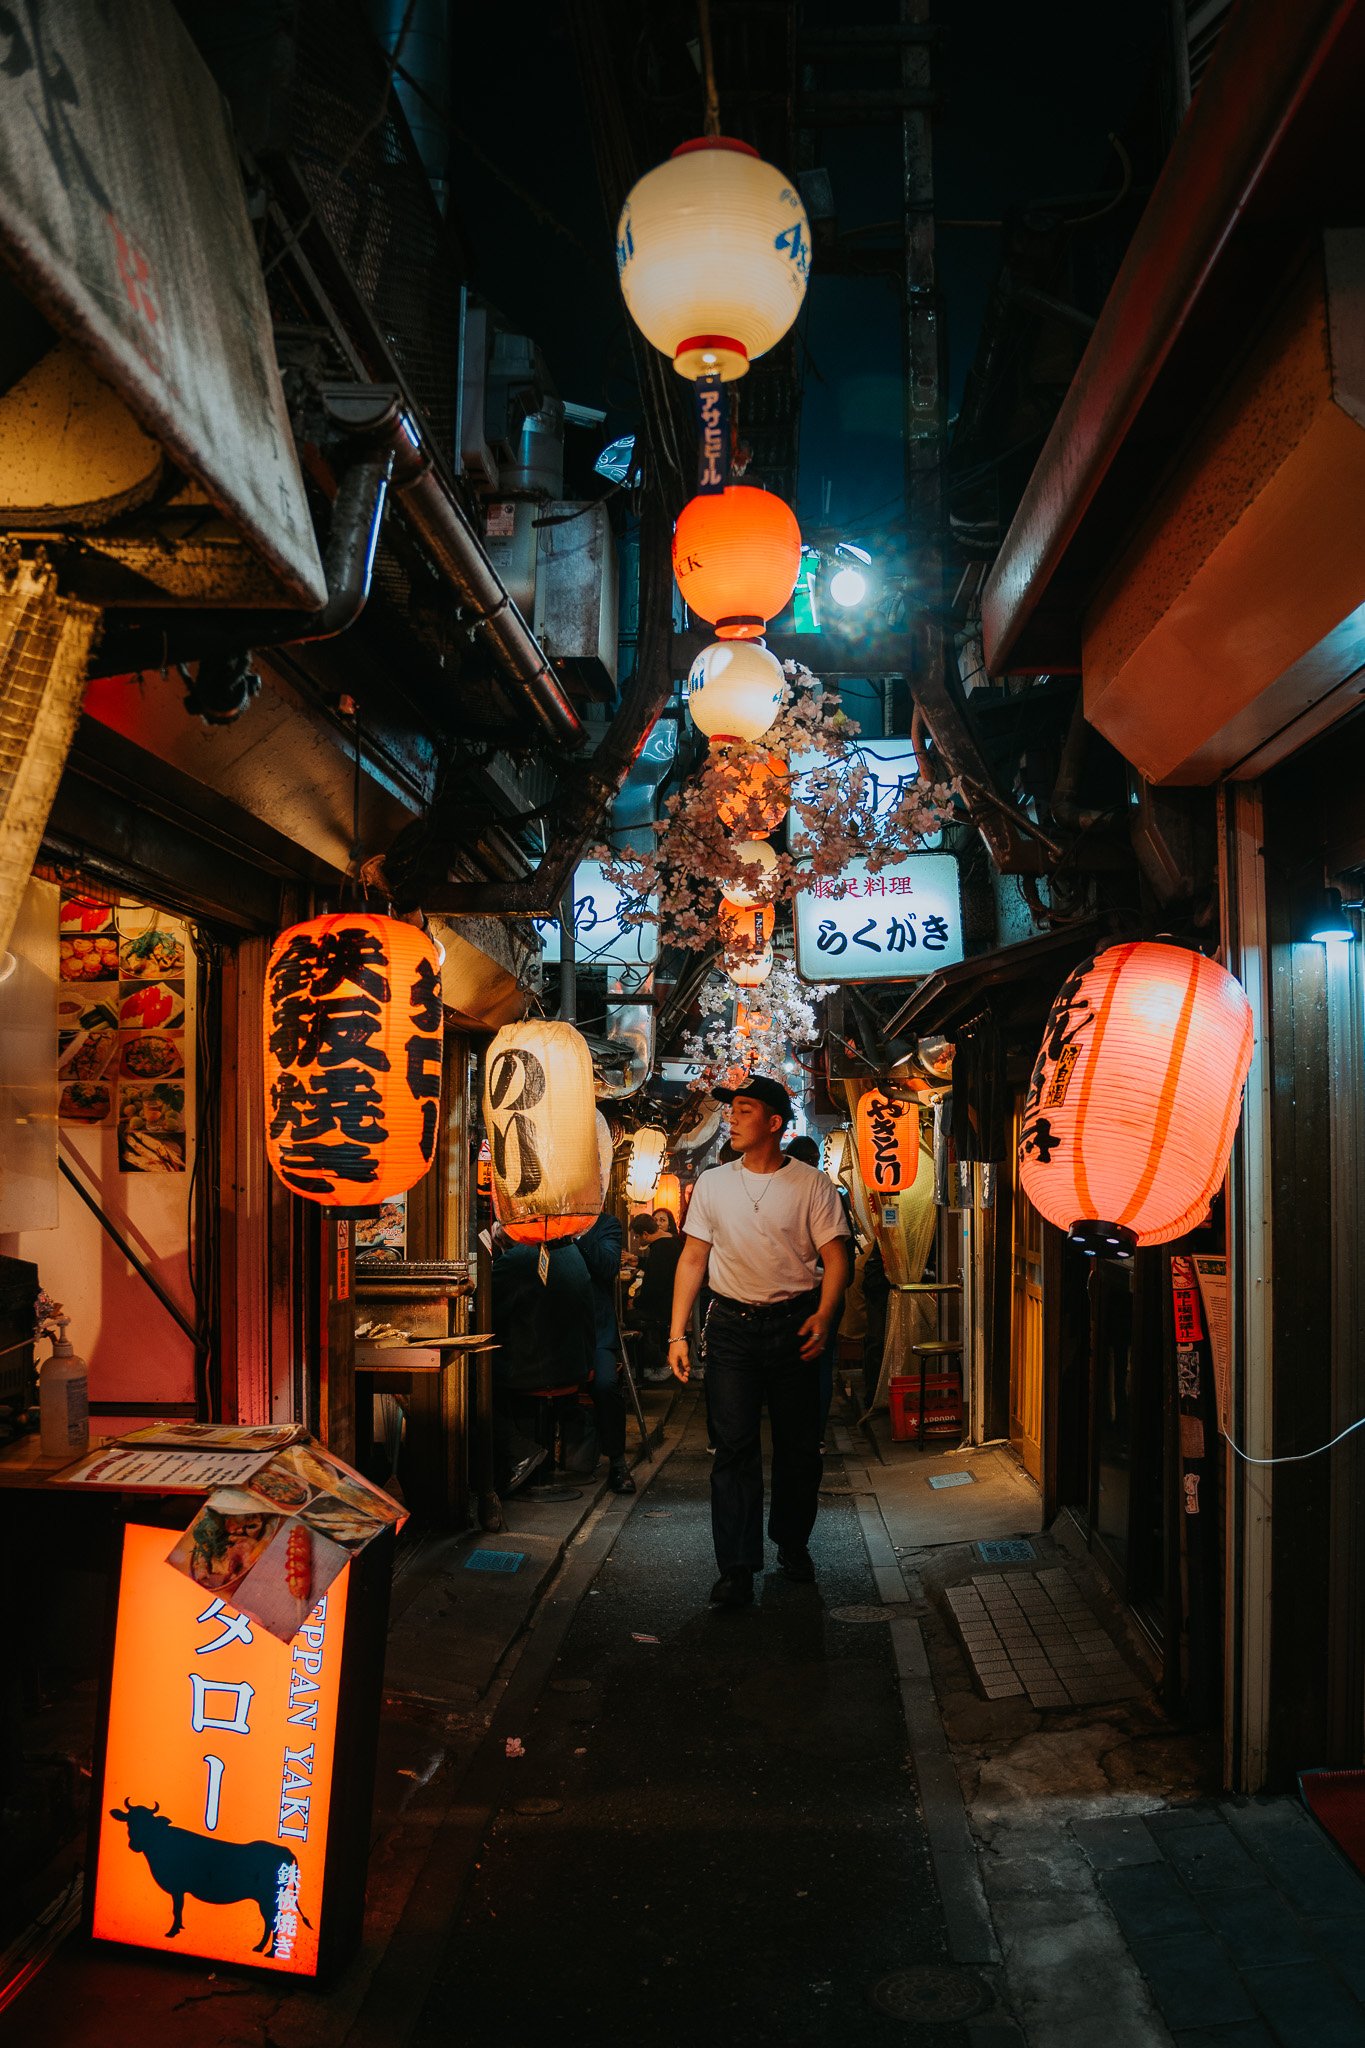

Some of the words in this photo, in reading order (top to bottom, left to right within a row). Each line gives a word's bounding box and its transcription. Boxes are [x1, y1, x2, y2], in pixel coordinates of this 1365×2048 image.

[700, 391, 721, 486] アサヒビール
[813, 875, 914, 899] 豚足料理
[816, 912, 949, 956] らくがき
[866, 1099, 902, 1187] やきとり
[924, 1415, 956, 1424] APPORO
[188, 1597, 255, 1832] タロー
[278, 1742, 316, 1842] YAKI
[273, 1861, 301, 1960] 鉄板焼き
